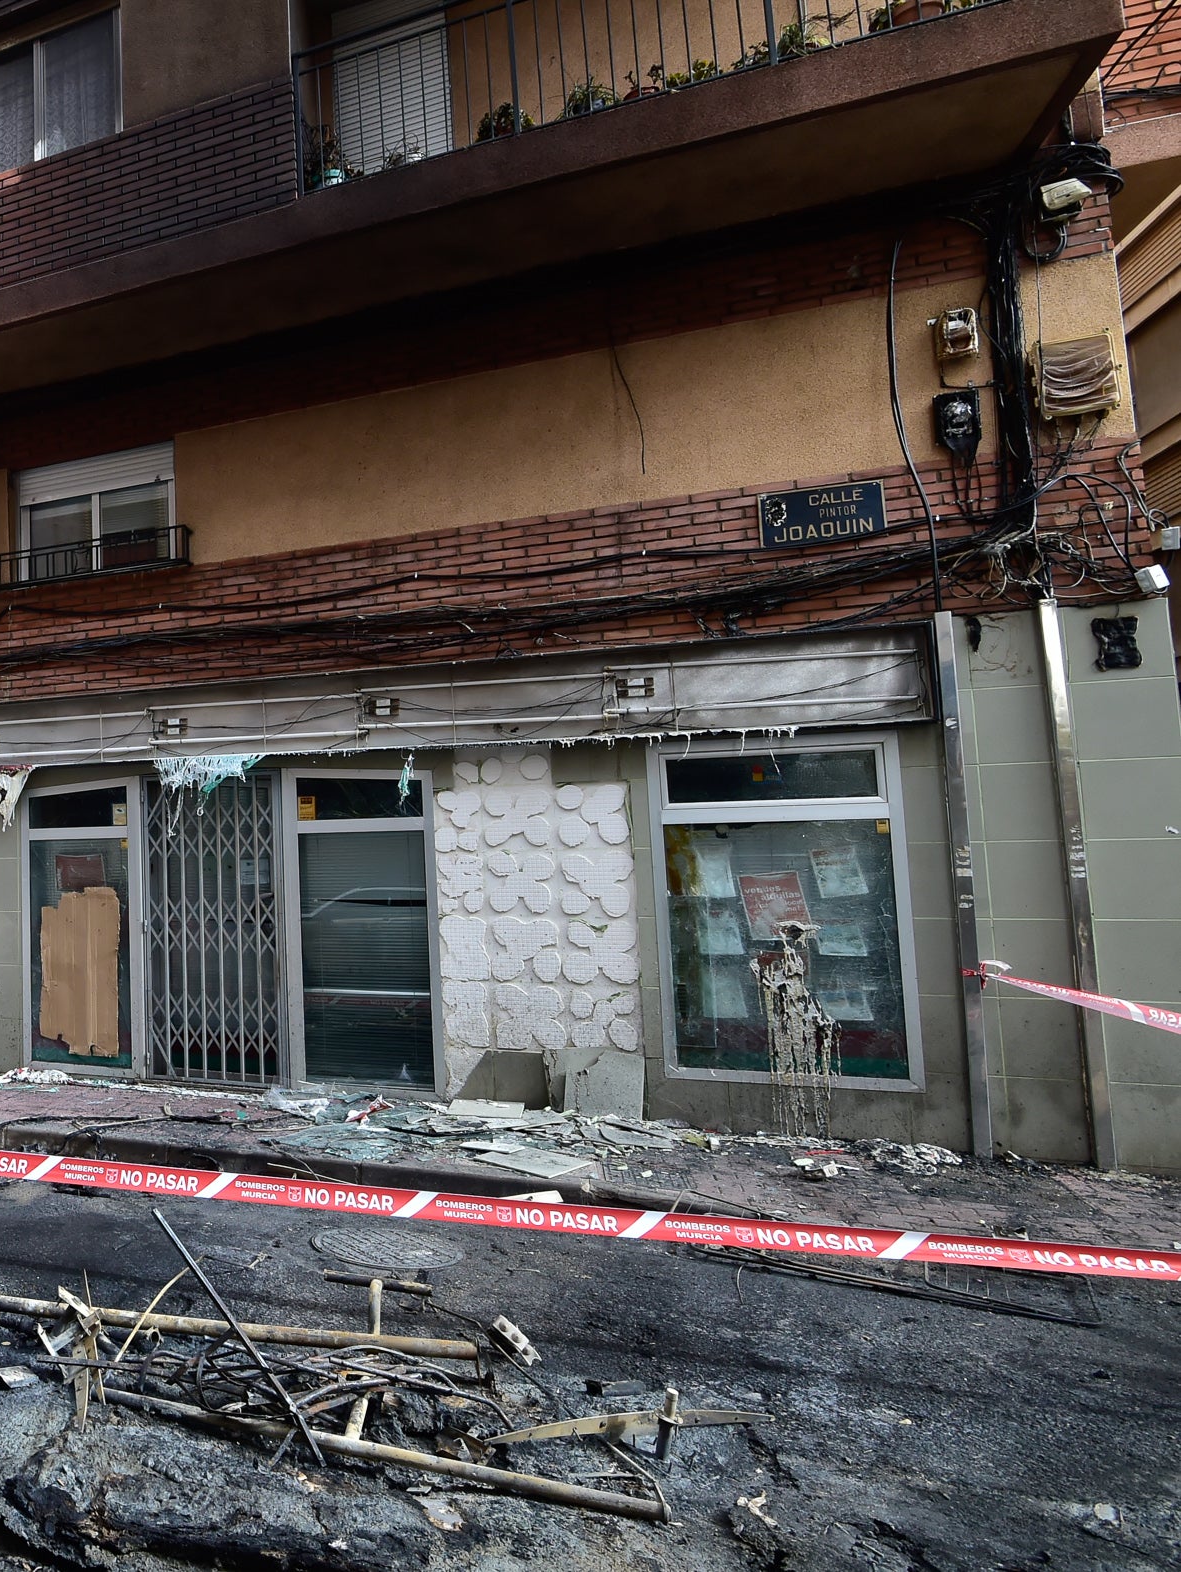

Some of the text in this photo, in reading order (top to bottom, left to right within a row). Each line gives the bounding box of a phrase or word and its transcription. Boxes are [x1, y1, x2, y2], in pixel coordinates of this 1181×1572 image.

[808, 489, 864, 506] CALLE
[819, 504, 857, 518] PINTOR
[774, 517, 874, 543] JOAQUIN
[59, 1163, 104, 1174] BOMBEROS
[64, 1172, 96, 1182] MURCIA
[119, 1169, 199, 1192] NO PASAR
[235, 1180, 286, 1192] BOMBEROS
[241, 1190, 277, 1200] MURCIA
[304, 1187, 394, 1212] NO PASAR
[435, 1200, 493, 1212] BOMBEROS
[443, 1210, 485, 1220] MURCIA
[515, 1207, 618, 1232] NO PASAR
[664, 1220, 731, 1233] BOMBEROS
[676, 1231, 724, 1241] MURCIA
[757, 1228, 877, 1253] NO PASAR
[928, 1241, 1004, 1255] BOMBEROS
[942, 1252, 999, 1262] MURCIA
[1032, 1250, 1177, 1274] NO PASAR
